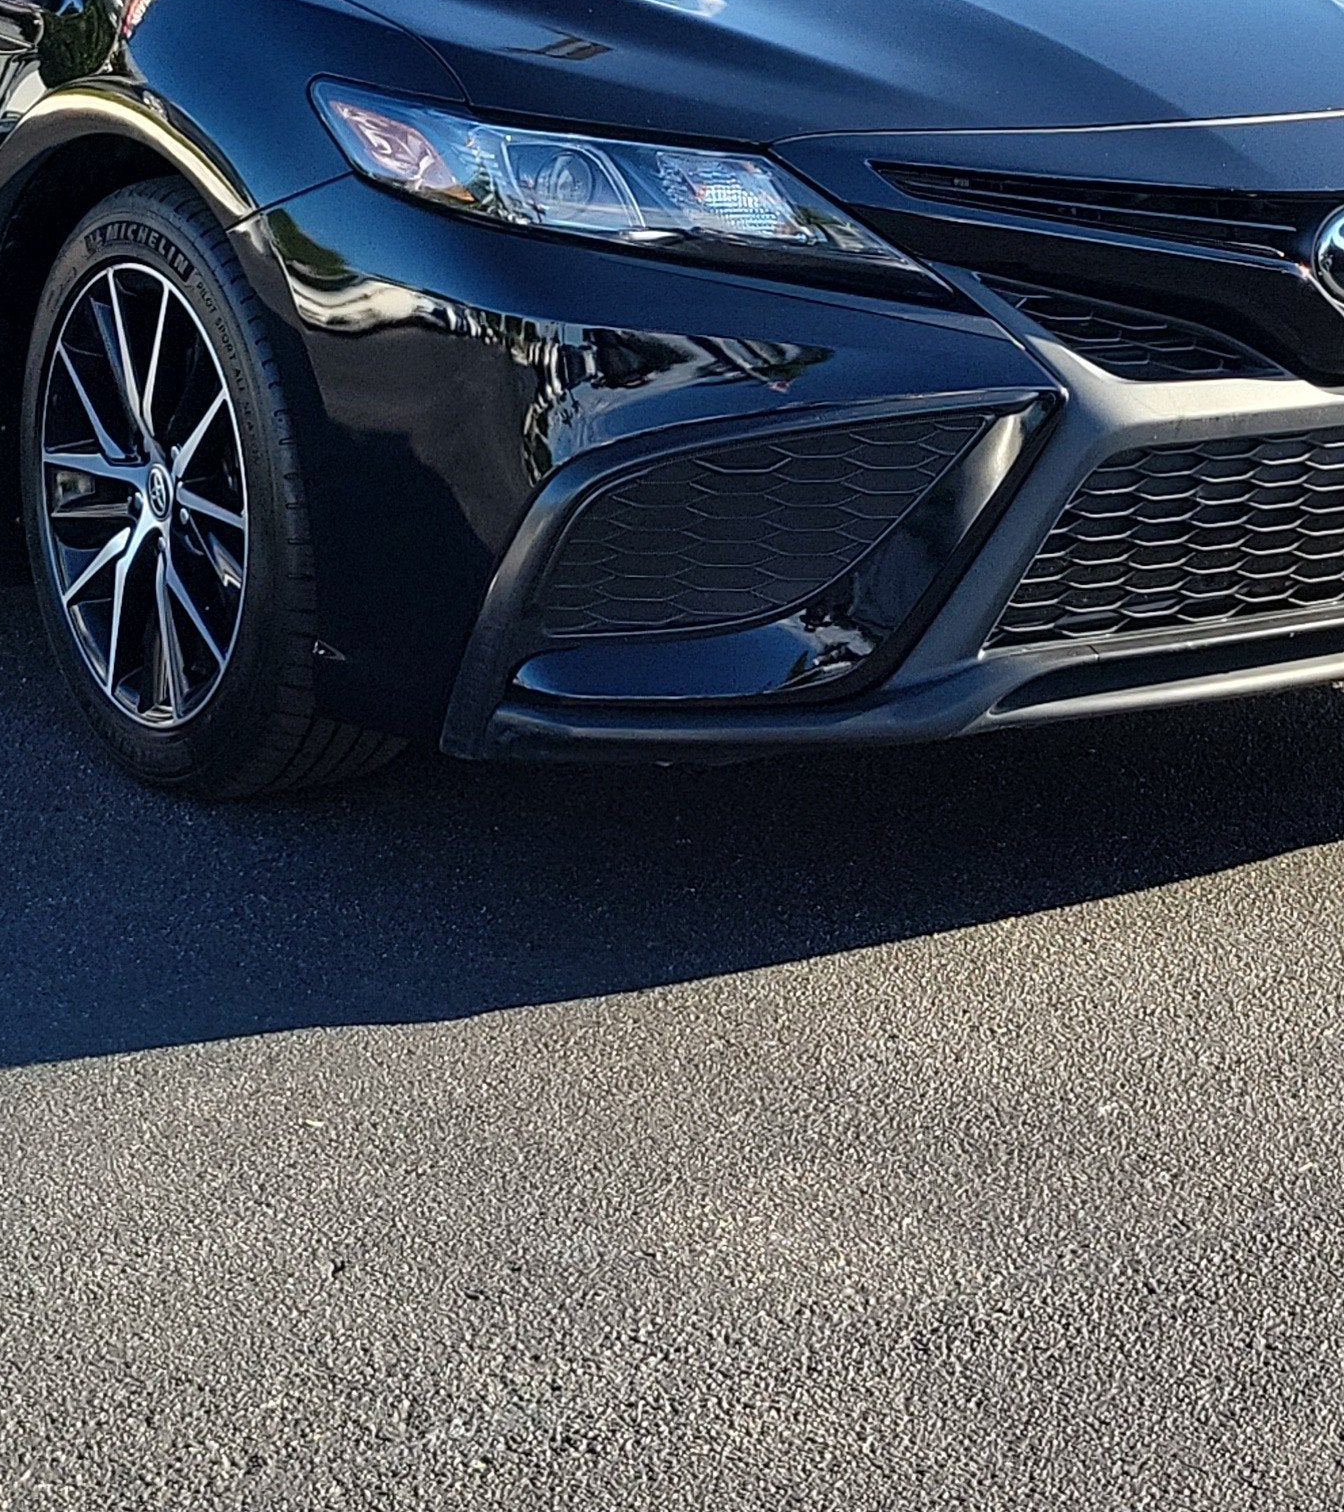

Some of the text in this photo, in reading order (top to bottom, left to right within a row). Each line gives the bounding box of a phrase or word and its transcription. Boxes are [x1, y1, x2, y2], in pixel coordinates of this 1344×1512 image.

[106, 223, 188, 276] MICHELIN
[196, 281, 218, 314] PILOT
[214, 317, 237, 361] SPORT
